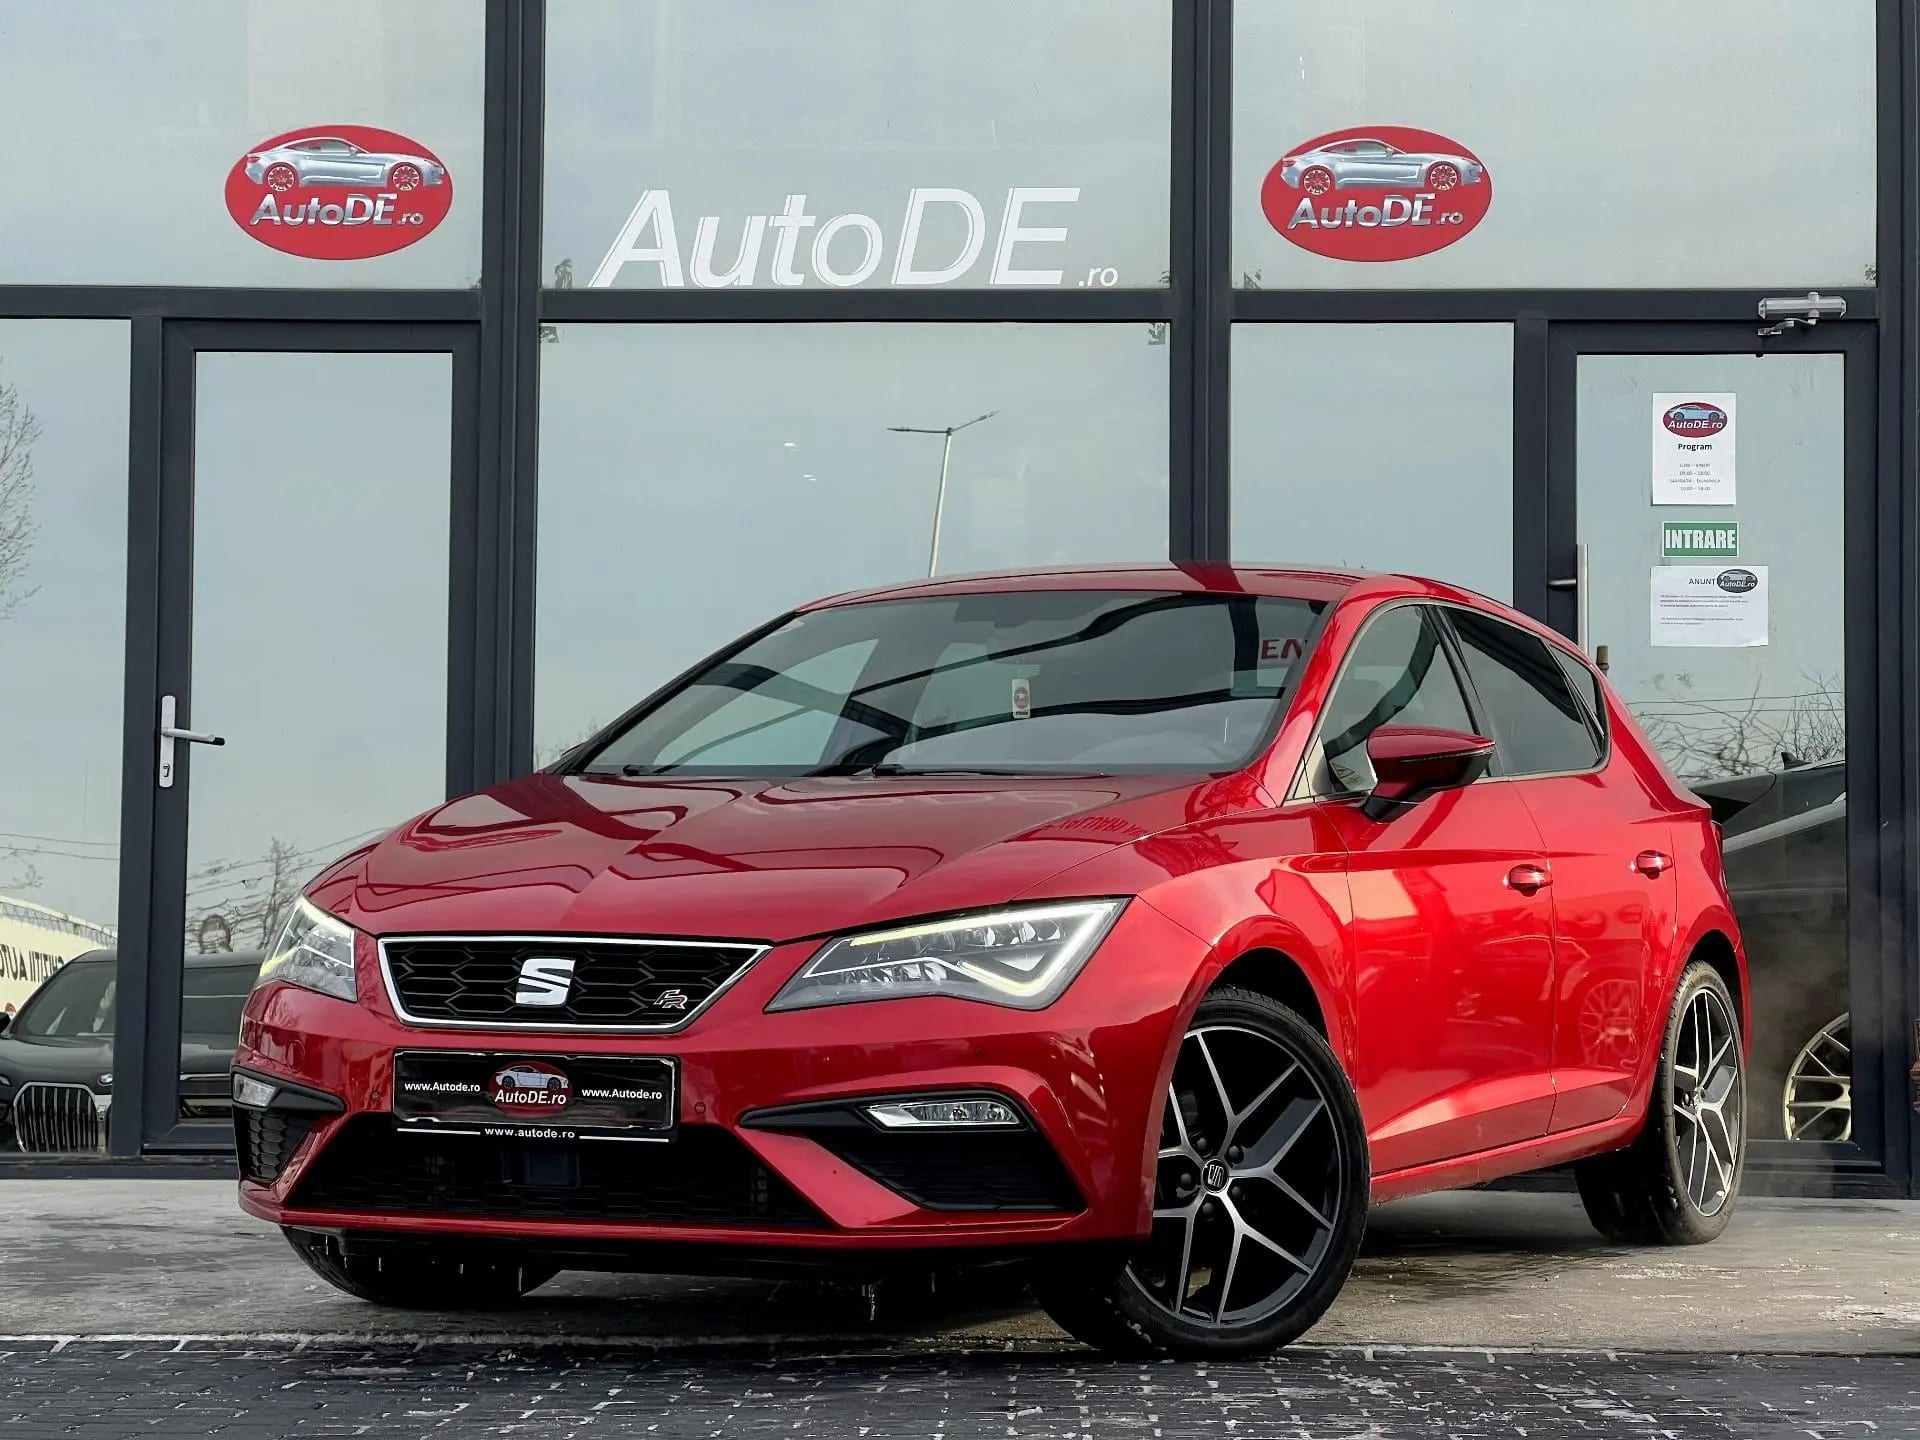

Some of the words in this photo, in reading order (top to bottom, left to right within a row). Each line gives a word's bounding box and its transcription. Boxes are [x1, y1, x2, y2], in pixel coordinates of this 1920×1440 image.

[249, 193, 424, 227] AutoDE.ro
[1287, 193, 1465, 230] AutoDE.ro
[1668, 420, 1723, 429] AutoDE.ro
[1677, 443, 1713, 452] Program
[1664, 529, 1736, 549] INTRARE
[404, 1081, 481, 1093] www.Autode.ro
[494, 1089, 567, 1106] AutoDE.ro
[581, 1088, 663, 1100] www.Autode.ro
[484, 1126, 576, 1139] www.autode.ro
